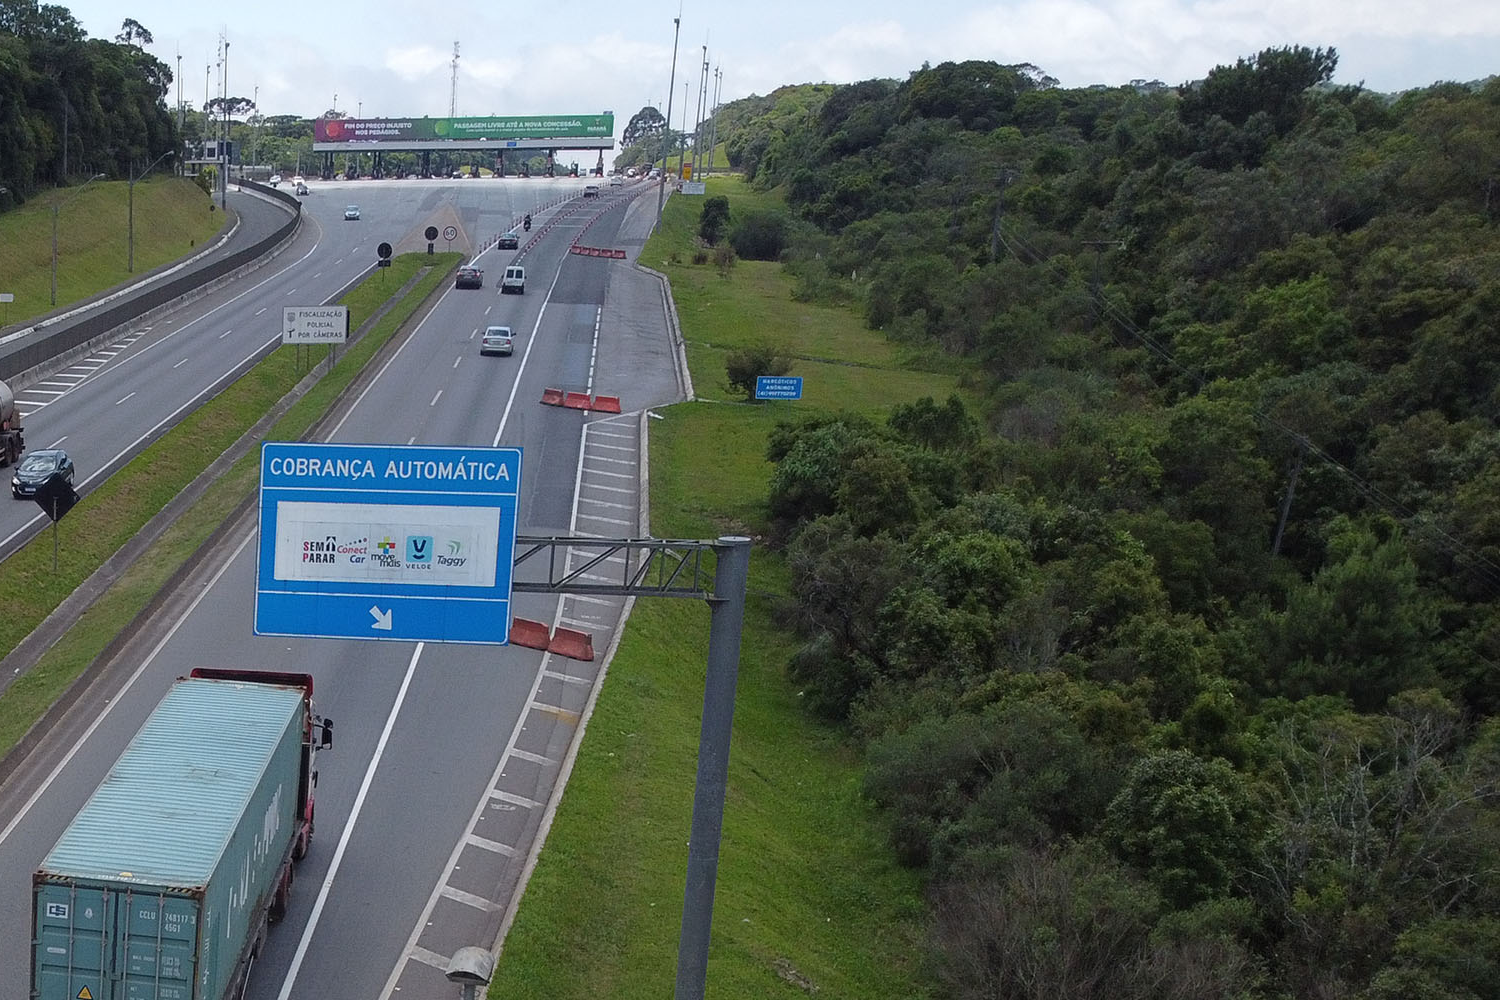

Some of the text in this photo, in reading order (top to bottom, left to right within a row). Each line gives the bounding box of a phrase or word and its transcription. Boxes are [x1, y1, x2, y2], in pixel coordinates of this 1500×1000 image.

[445, 229, 455, 237] 60
[313, 330, 343, 338] CÂMERAS
[270, 456, 510, 481] COBRANÇA AUTOMÁTICA
[303, 541, 324, 552] SEM
[337, 545, 368, 555] Conect
[303, 552, 335, 564] PARAR
[349, 555, 366, 564] Car
[371, 554, 396, 562] move
[437, 555, 467, 567] Taggy
[379, 559, 401, 568] mais
[139, 910, 156, 920] CCLU
[164, 913, 188, 924] 748117
[164, 923, 181, 933] 45G1
